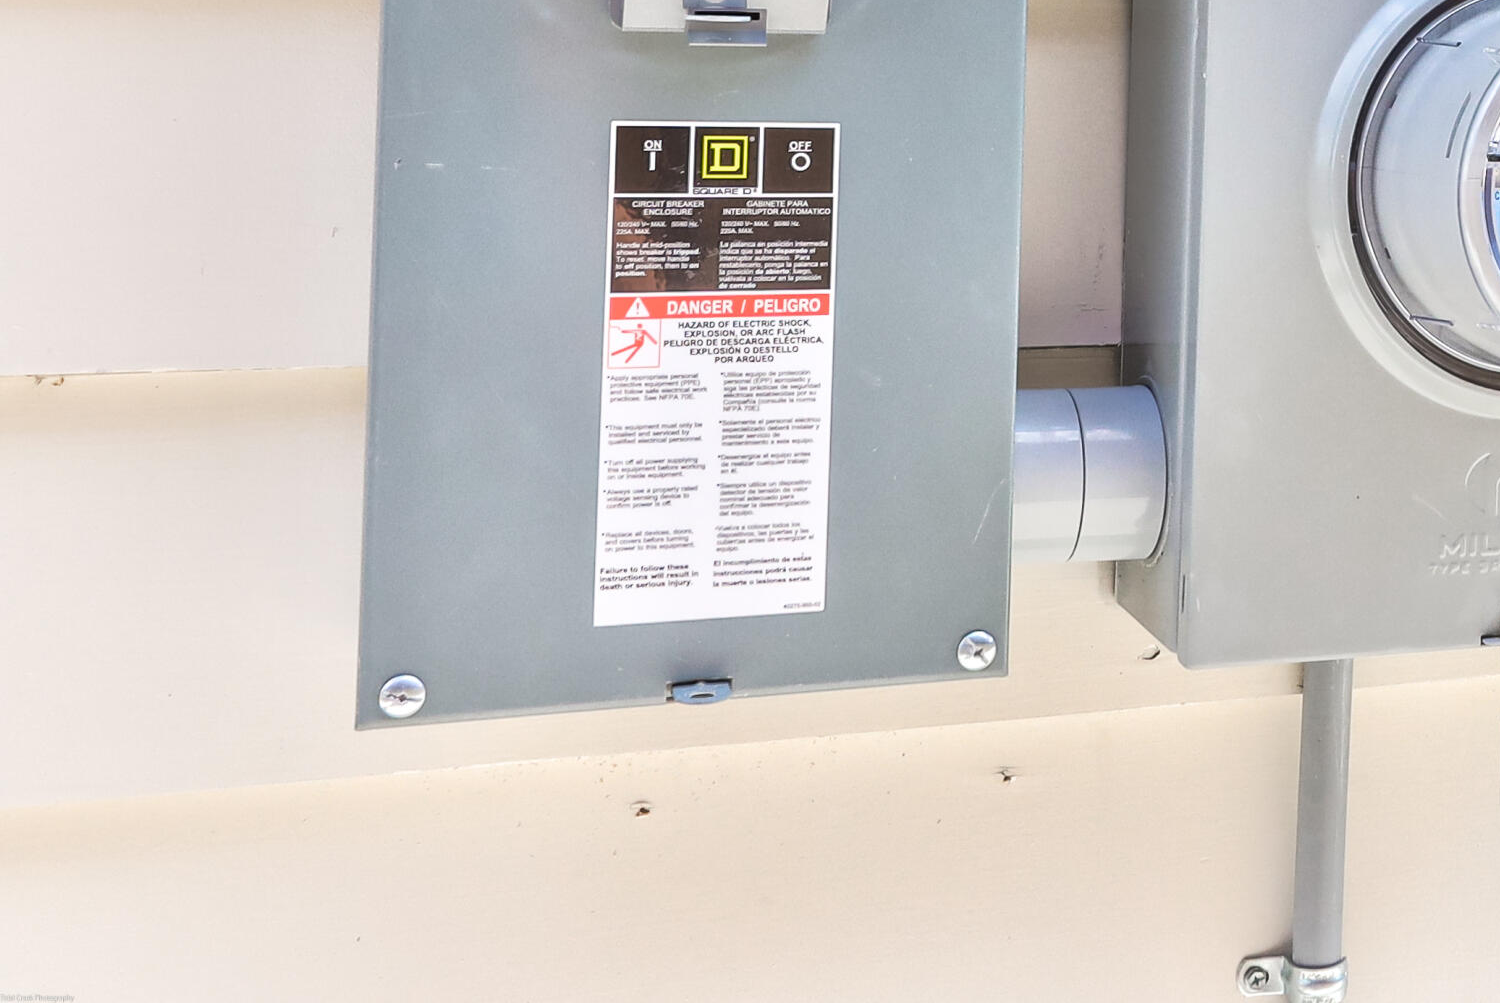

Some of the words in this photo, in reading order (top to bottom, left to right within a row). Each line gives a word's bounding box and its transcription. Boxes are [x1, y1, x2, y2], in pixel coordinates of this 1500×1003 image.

[644, 140, 662, 149] ON
[789, 141, 812, 150] OFF
[710, 143, 740, 171] D
[667, 299, 733, 314] DANGER
[741, 300, 746, 313] /
[754, 298, 821, 313] PELIGRO
[679, 321, 714, 329] HAZARD
[733, 320, 775, 328] ELECTRIC
[684, 329, 737, 337] EXPLOSION,
[664, 338, 699, 347] PELIGRO
[703, 338, 716, 346] DE
[720, 337, 770, 345] DESCARGA
[773, 335, 824, 345] ELÉCTRICA,
[690, 346, 740, 355] EXPLOSIÓN
[745, 346, 750, 354] O
[753, 345, 799, 353] DESTELLO
[715, 355, 733, 363] POR
[736, 355, 774, 363] ARQUEO
[1430, 563, 1470, 574] TYPE
